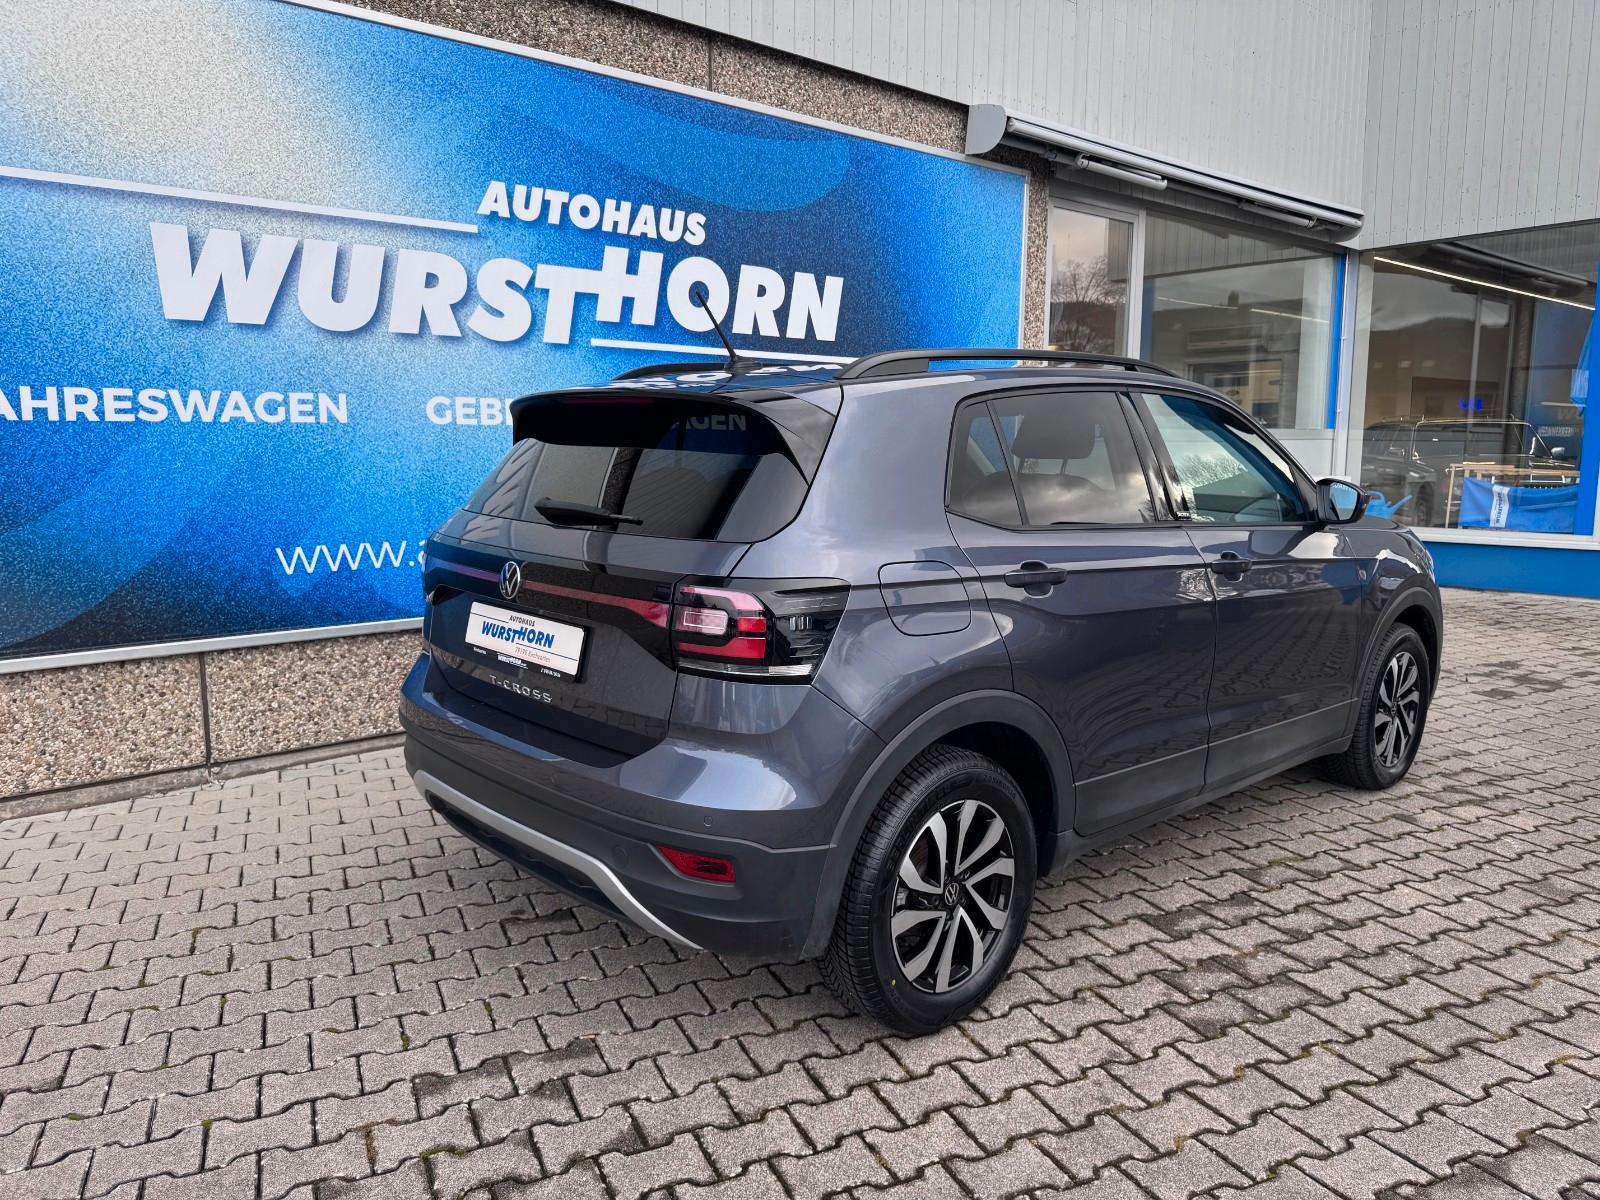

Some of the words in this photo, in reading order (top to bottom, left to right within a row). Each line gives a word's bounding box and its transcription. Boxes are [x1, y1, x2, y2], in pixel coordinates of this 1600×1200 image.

[477, 180, 706, 246] AUTOHAUS
[150, 222, 845, 345] WURSTHORN
[481, 620, 556, 649] WURSTHORN
[508, 614, 536, 627] AUTOHAUS
[489, 674, 553, 703] T-CROSS
